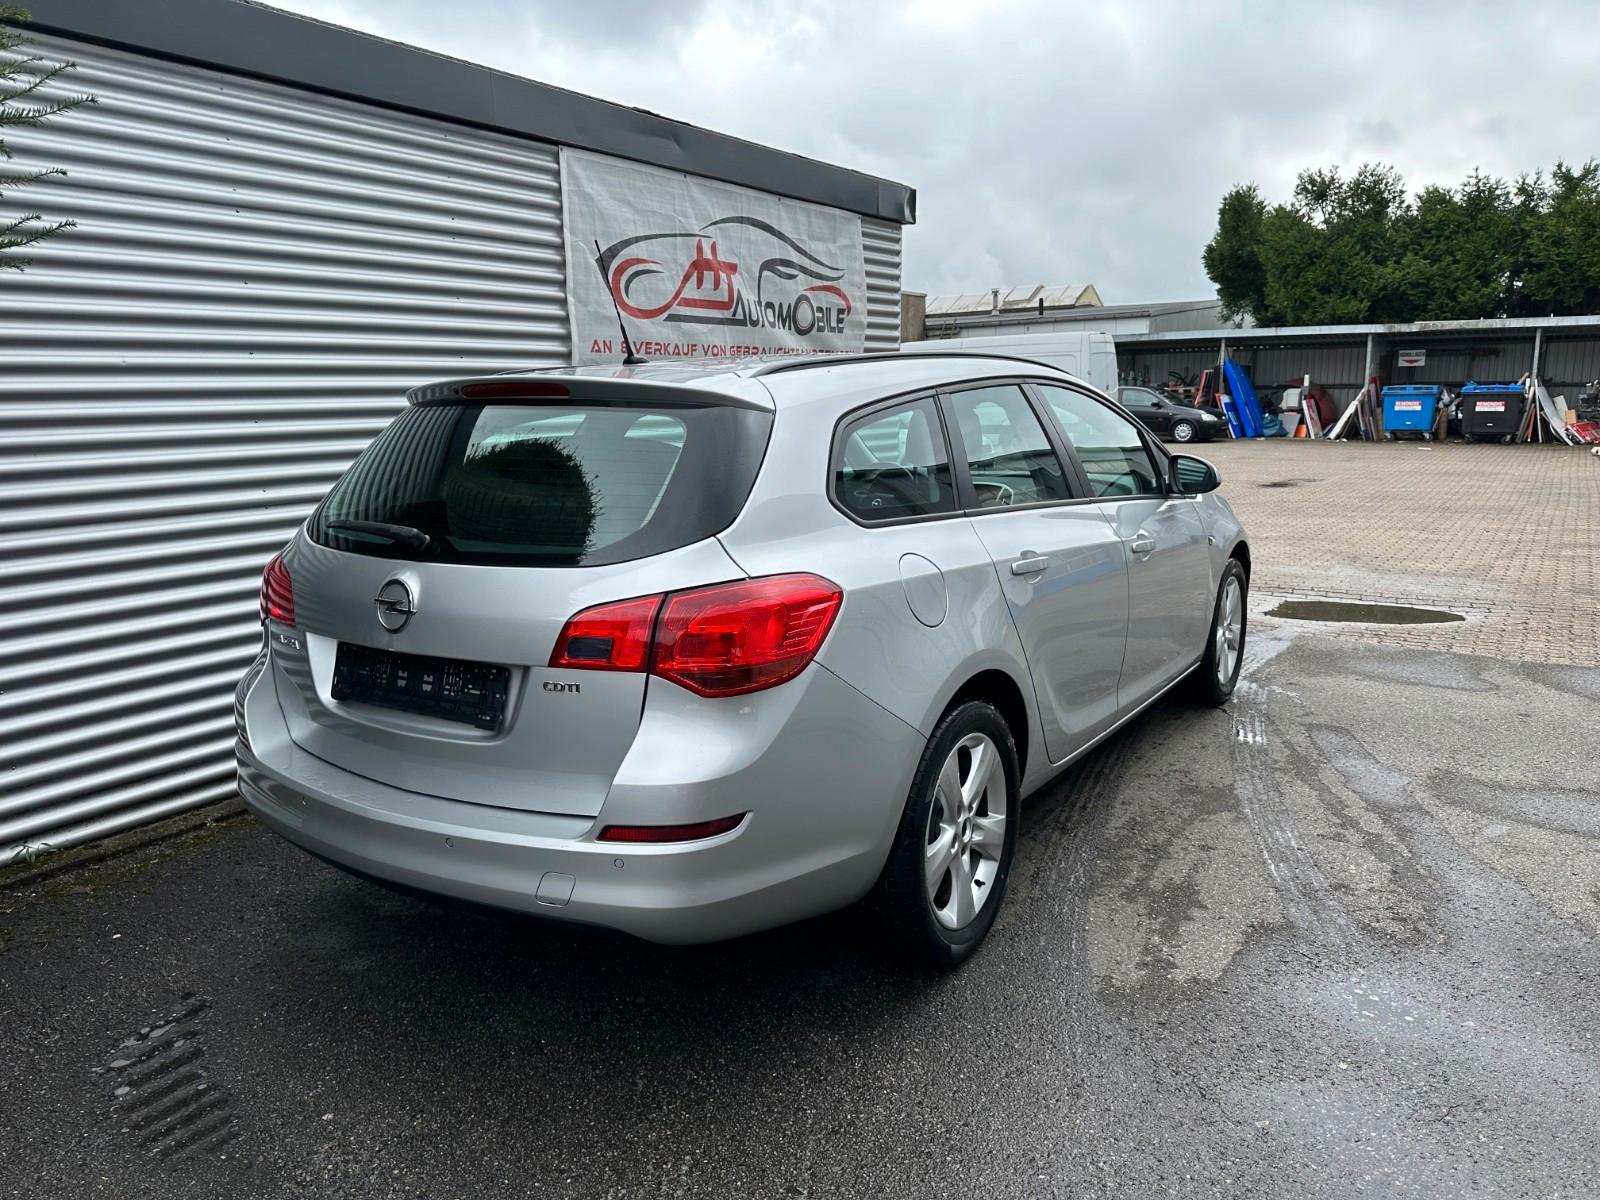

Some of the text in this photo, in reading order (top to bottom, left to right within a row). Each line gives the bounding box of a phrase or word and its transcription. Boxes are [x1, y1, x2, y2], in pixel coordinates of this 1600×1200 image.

[664, 288, 846, 336] AUTOMOBILE
[590, 339, 612, 354] AN
[633, 340, 698, 356] VERKAUF
[702, 343, 727, 357] VON
[543, 681, 581, 693] CDTI
